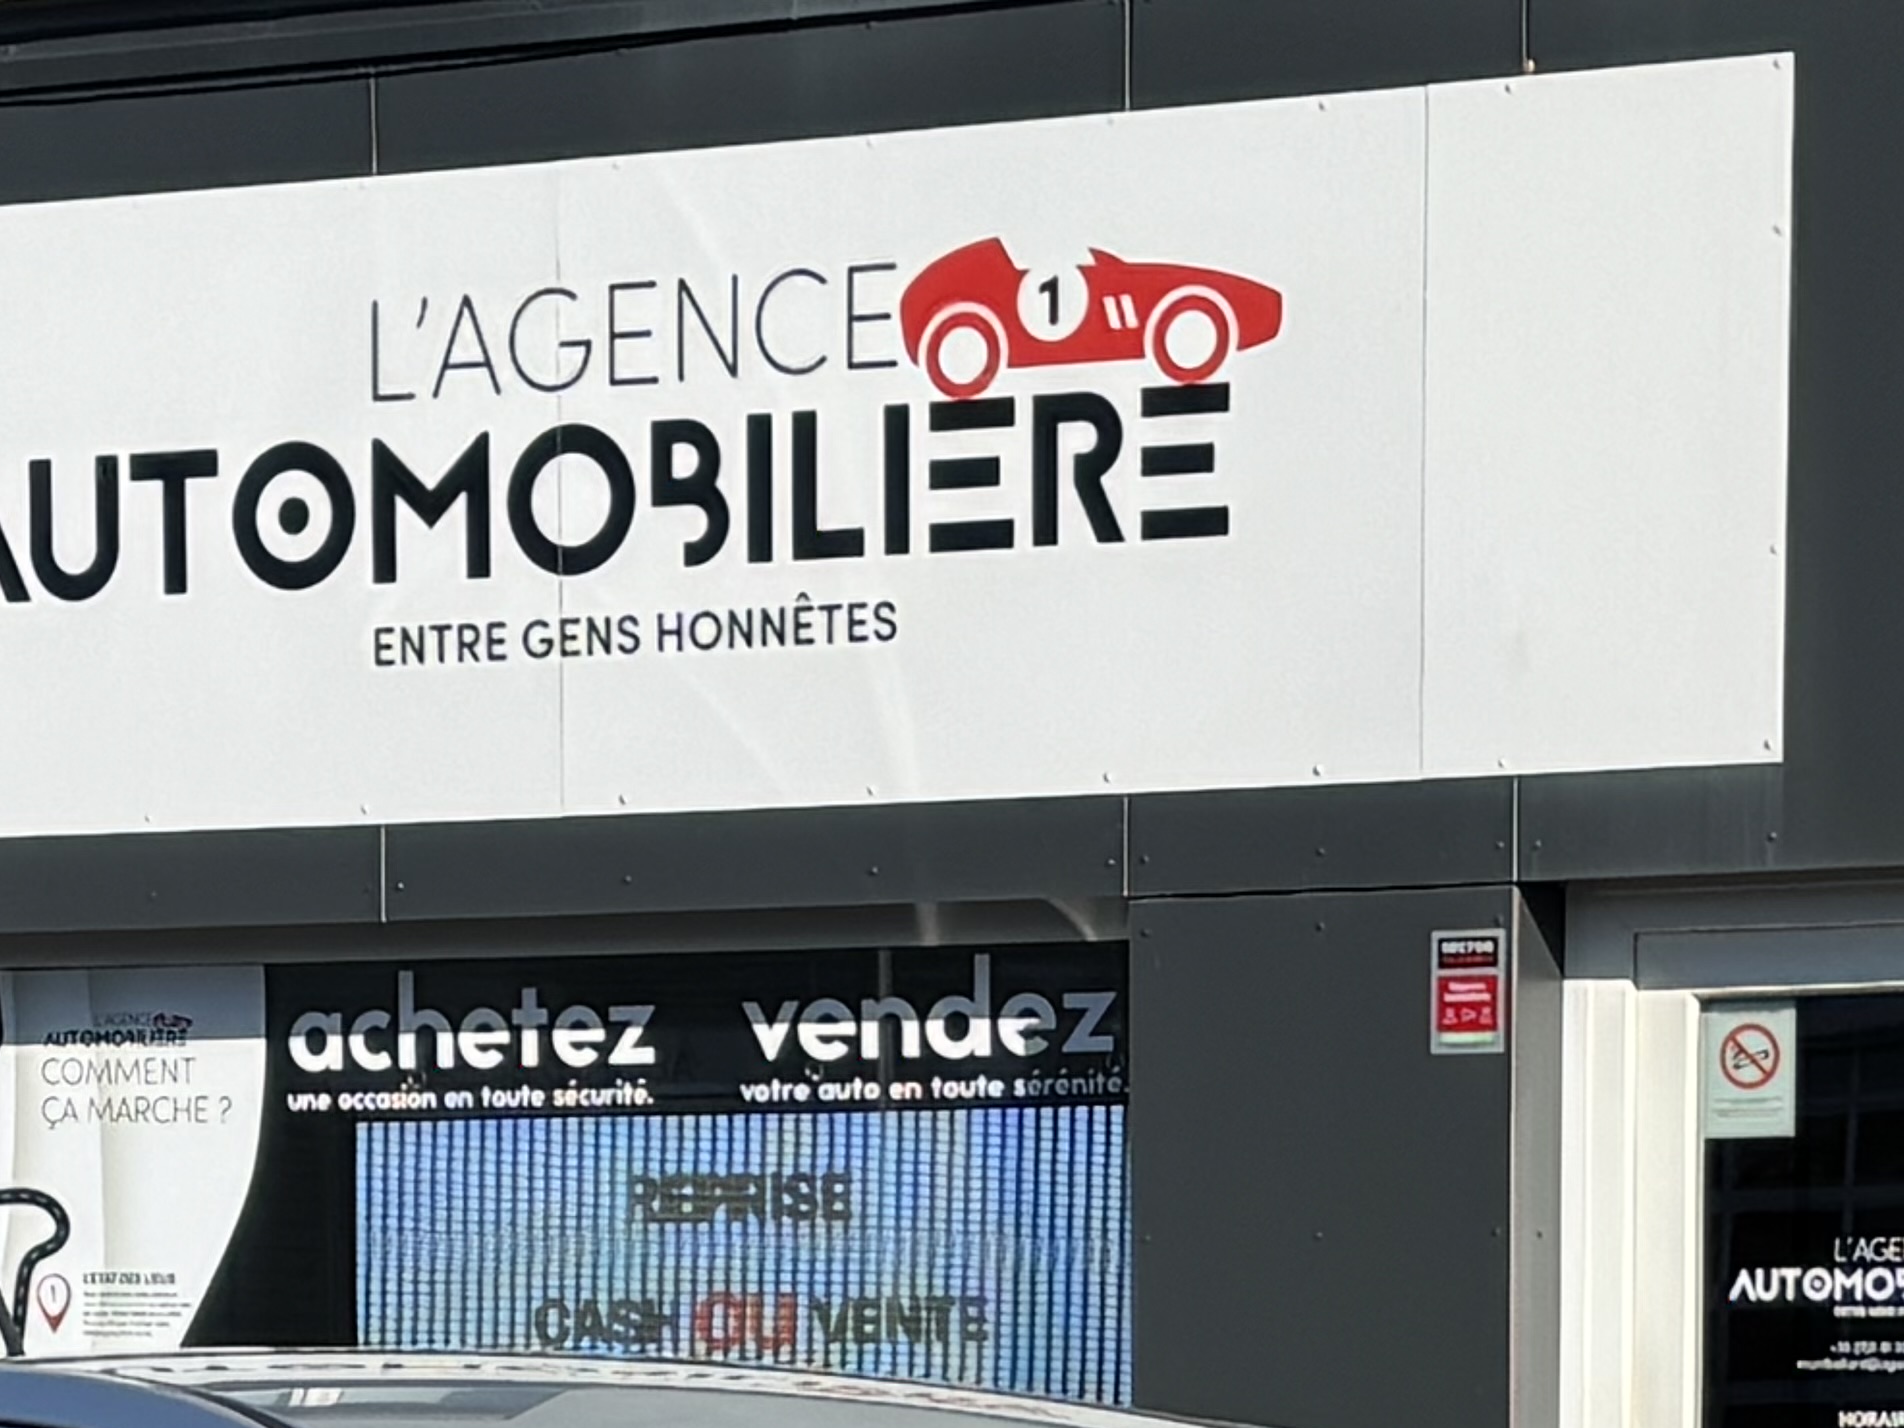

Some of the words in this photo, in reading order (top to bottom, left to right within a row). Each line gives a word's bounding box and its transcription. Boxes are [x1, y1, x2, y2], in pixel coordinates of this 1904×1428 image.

[371, 263, 898, 401] L'AGENCE
[375, 622, 507, 666] ENTRE
[522, 615, 640, 658] GENS
[657, 592, 897, 652] HONNÊTES
[288, 970, 656, 1073] achetez
[742, 953, 1117, 1062] vendez
[40, 1057, 197, 1085] COMMENT
[288, 1094, 331, 1111] une
[338, 1084, 437, 1110] occasion
[444, 1091, 473, 1108] en
[481, 1085, 545, 1107] toute
[553, 1079, 653, 1106] sécurité.
[740, 1079, 810, 1102] votre
[818, 1077, 880, 1100] auto
[889, 1082, 922, 1100] en
[931, 1075, 1004, 1098] toute
[1013, 1066, 1129, 1096] sérénité.
[40, 1096, 79, 1130] ÇA
[86, 1095, 210, 1124] MARCHE
[218, 1095, 233, 1124] ?
[534, 1299, 678, 1349] CASH
[696, 1291, 794, 1348] OU
[810, 1295, 988, 1343] VENTE
